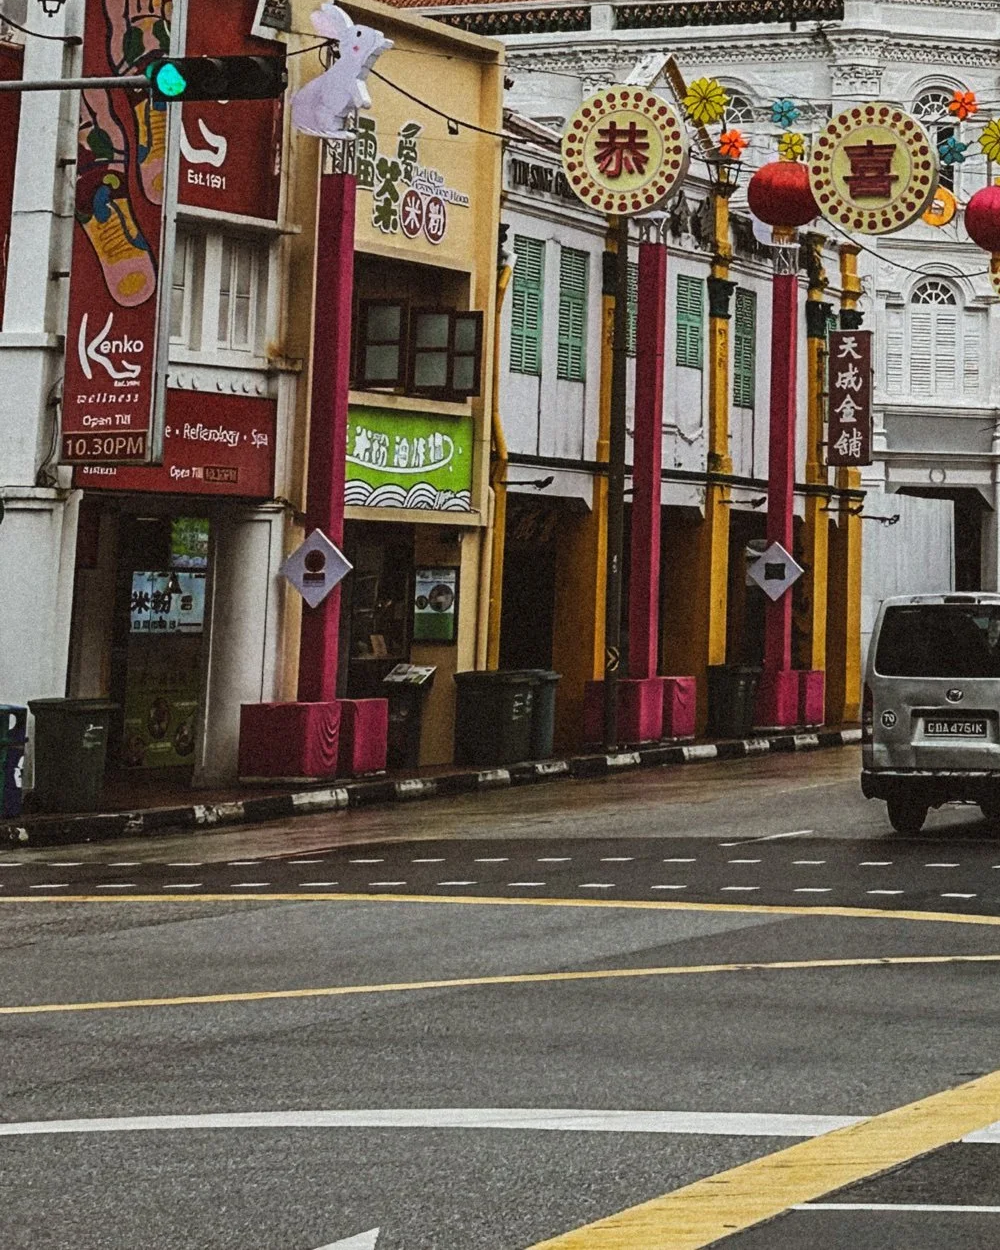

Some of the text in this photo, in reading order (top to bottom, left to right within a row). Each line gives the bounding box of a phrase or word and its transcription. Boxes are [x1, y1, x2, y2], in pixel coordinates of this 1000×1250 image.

[595, 120, 650, 178] 恭
[842, 139, 897, 198] 喜
[78, 312, 144, 380] Kenko
[66, 436, 144, 455] 10.30PM
[82, 415, 112, 428] Open
